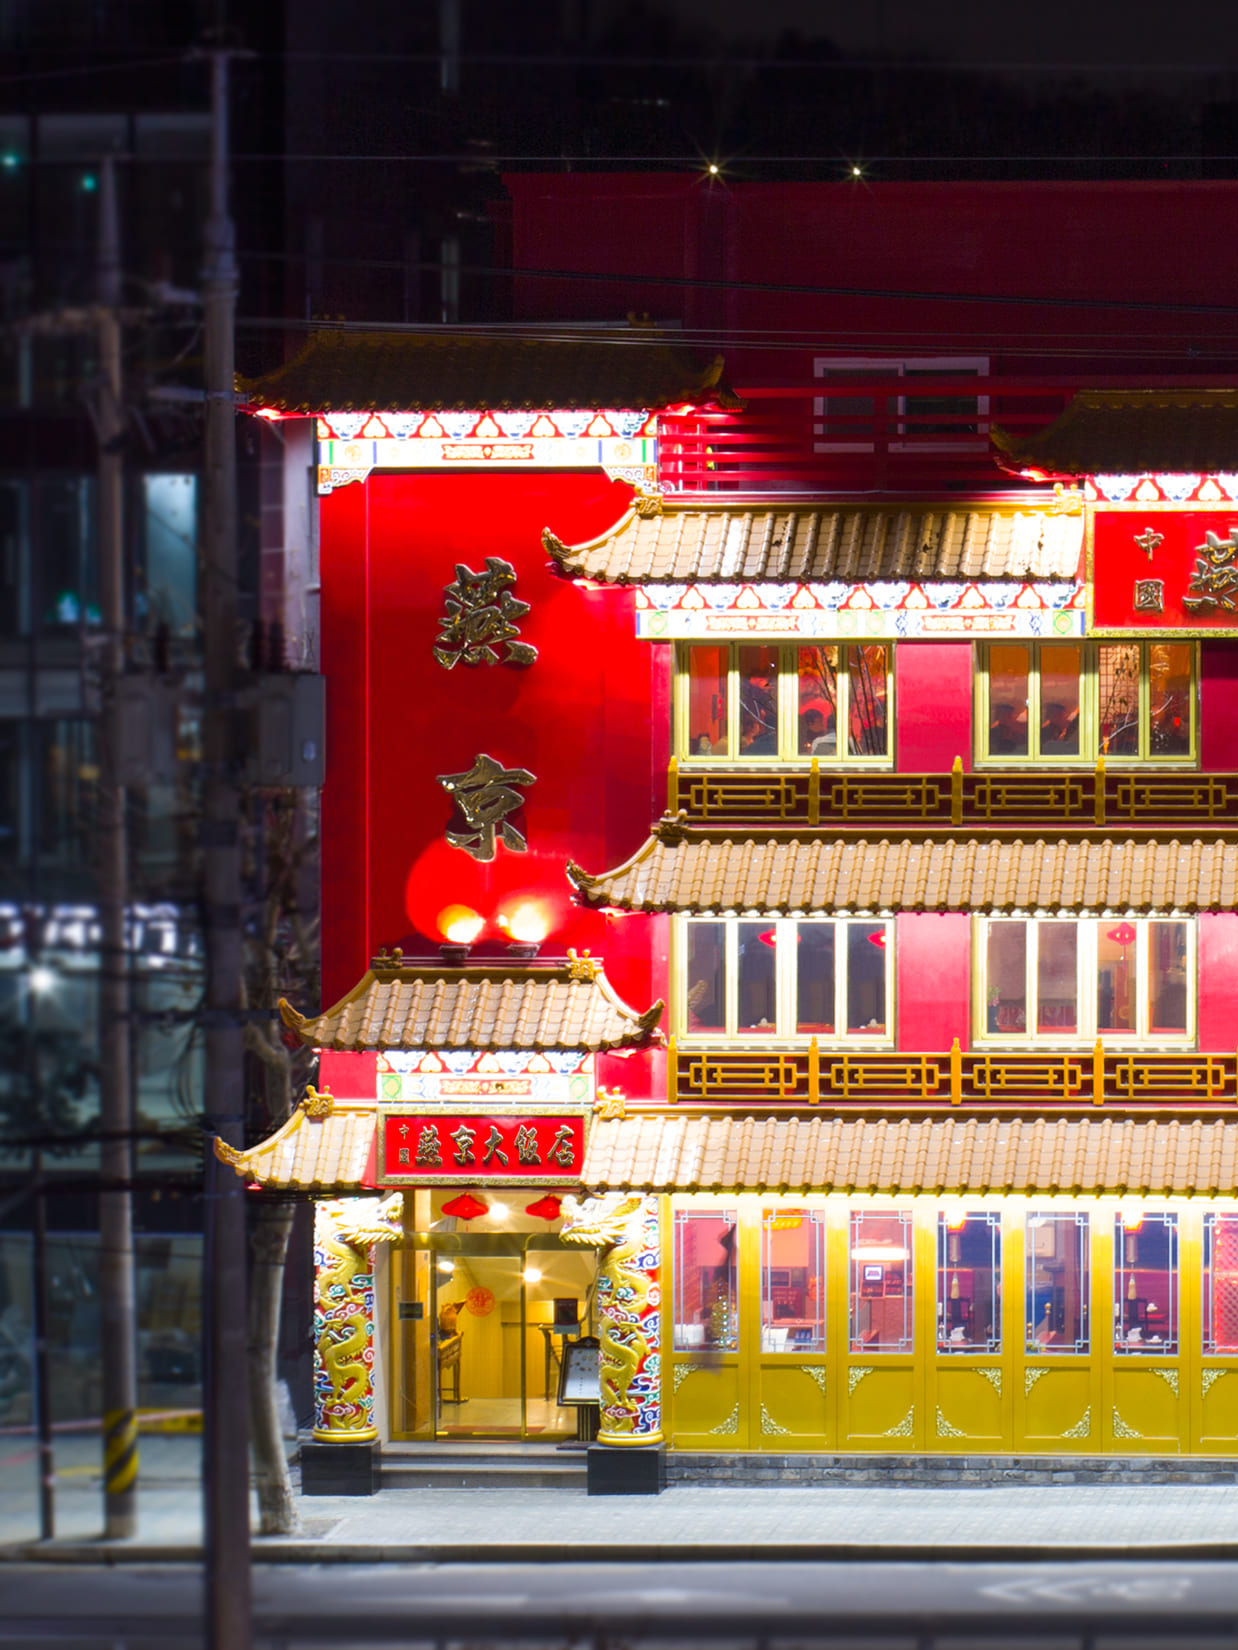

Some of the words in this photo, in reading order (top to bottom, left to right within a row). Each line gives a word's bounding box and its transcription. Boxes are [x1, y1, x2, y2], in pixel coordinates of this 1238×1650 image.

[1132, 526, 1165, 612] 中國
[432, 556, 539, 863] 燕京
[415, 1124, 575, 1166] 燕京大飯店
